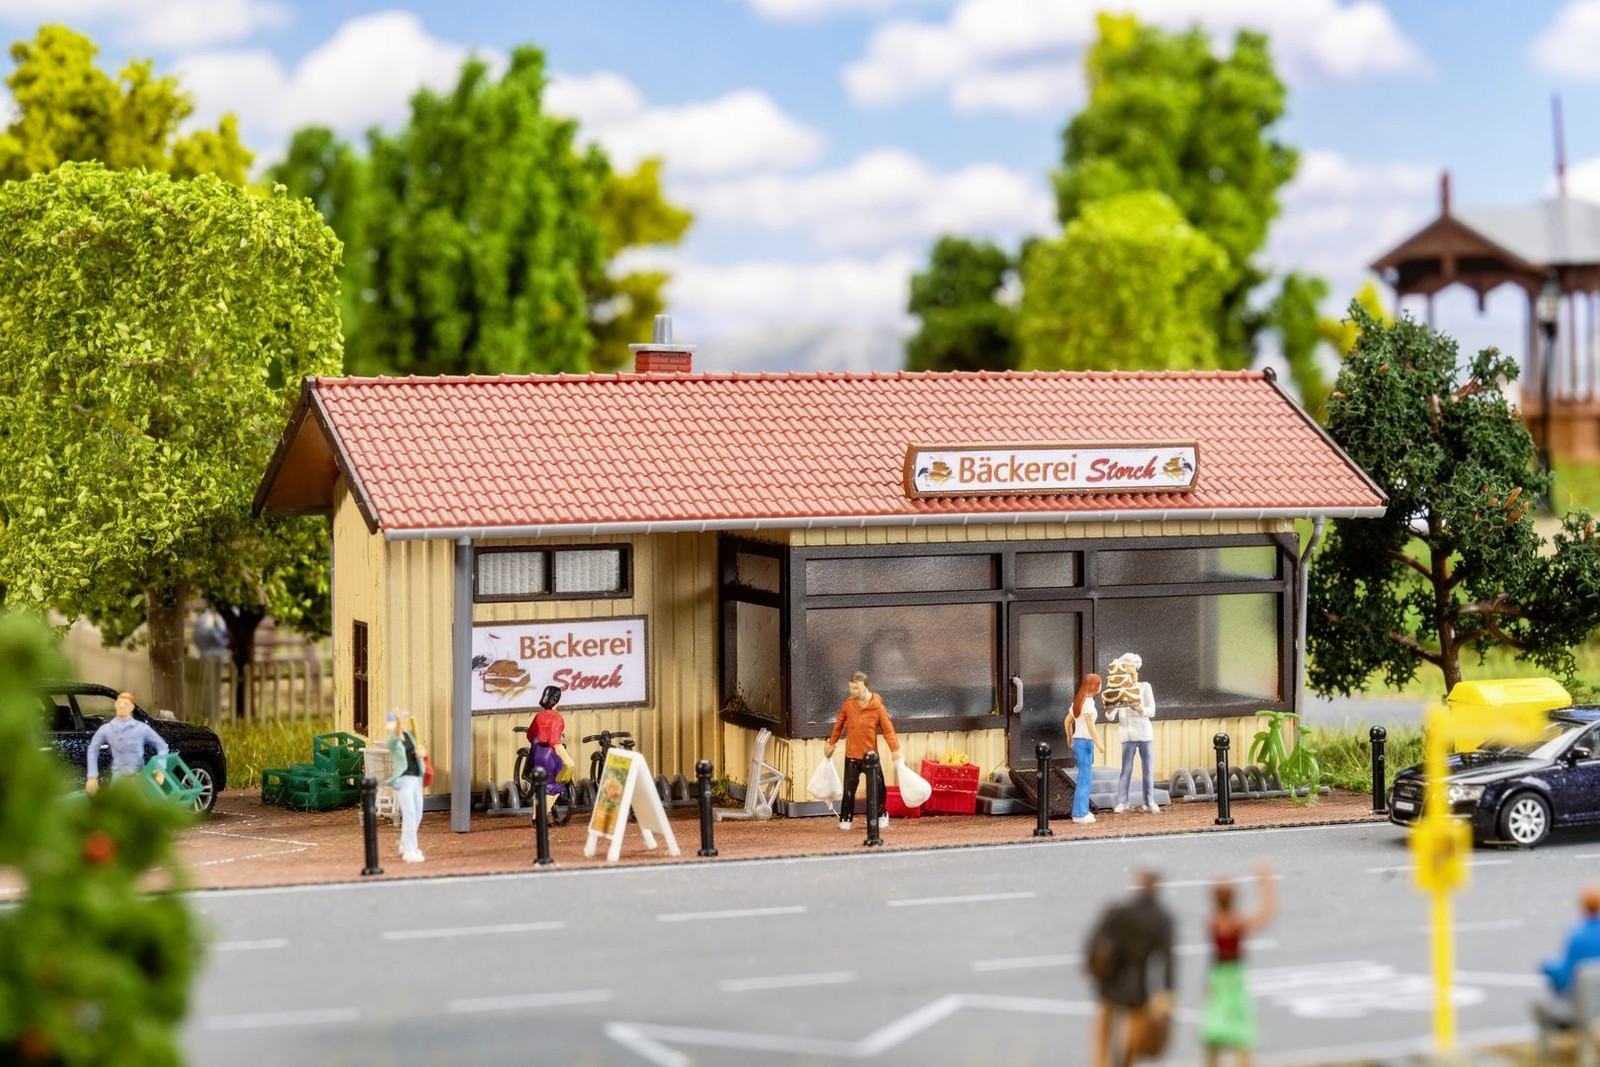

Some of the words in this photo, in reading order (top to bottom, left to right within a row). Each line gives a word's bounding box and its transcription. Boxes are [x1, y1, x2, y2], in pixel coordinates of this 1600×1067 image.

[958, 454, 1077, 483] Bäckerei
[1085, 455, 1159, 483] Storch
[519, 629, 633, 660] Bäckerei
[553, 664, 624, 692] Storch
